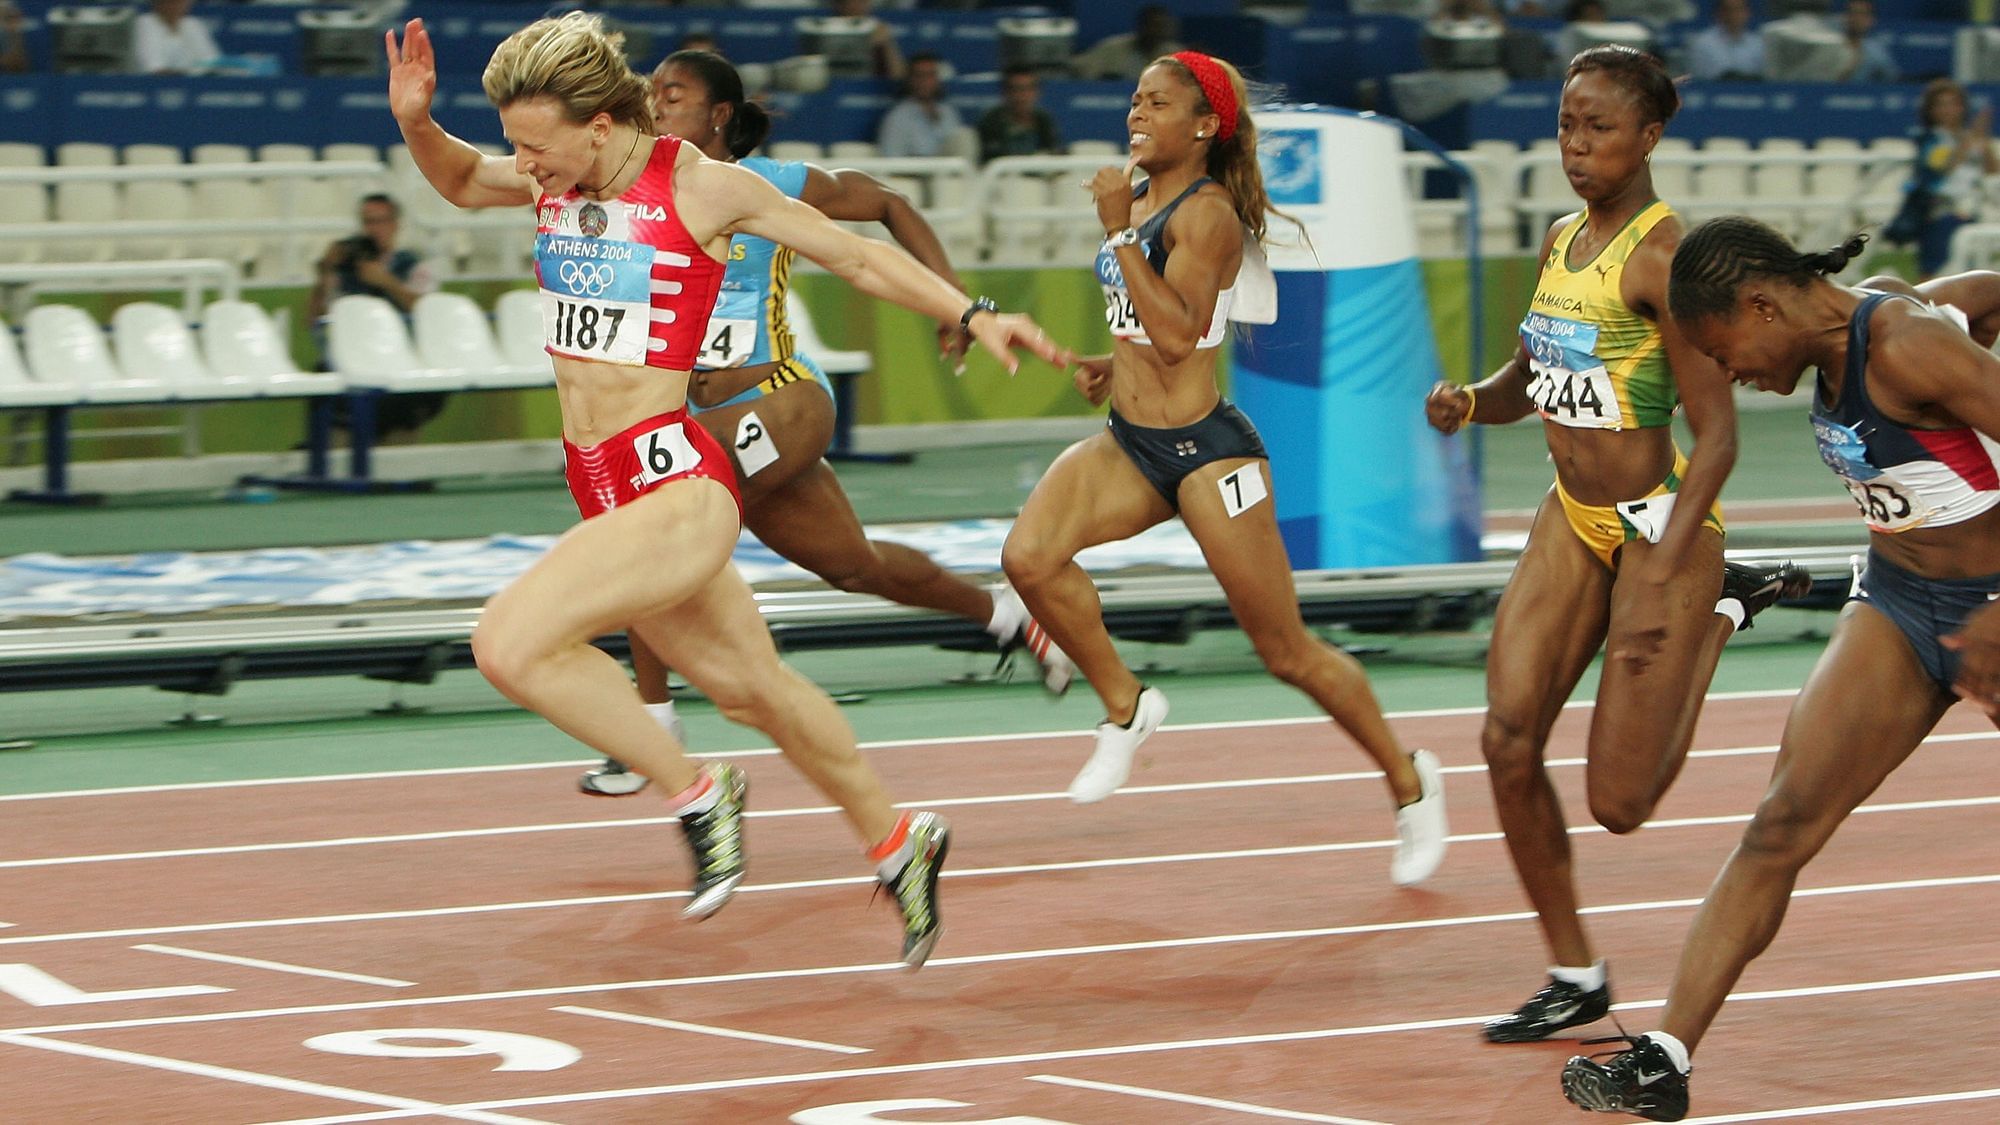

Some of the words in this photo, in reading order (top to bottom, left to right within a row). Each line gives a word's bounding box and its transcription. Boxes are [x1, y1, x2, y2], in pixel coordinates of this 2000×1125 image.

[623, 203, 667, 221] FILA
[547, 239, 600, 258] ATHENS
[600, 245, 633, 261] 2004
[1534, 290, 1583, 314] JAMAICA
[555, 300, 626, 352] 1187
[699, 325, 732, 361] 4
[647, 432, 673, 474] 6
[629, 470, 647, 492] FI
[1225, 472, 1243, 509] 7
